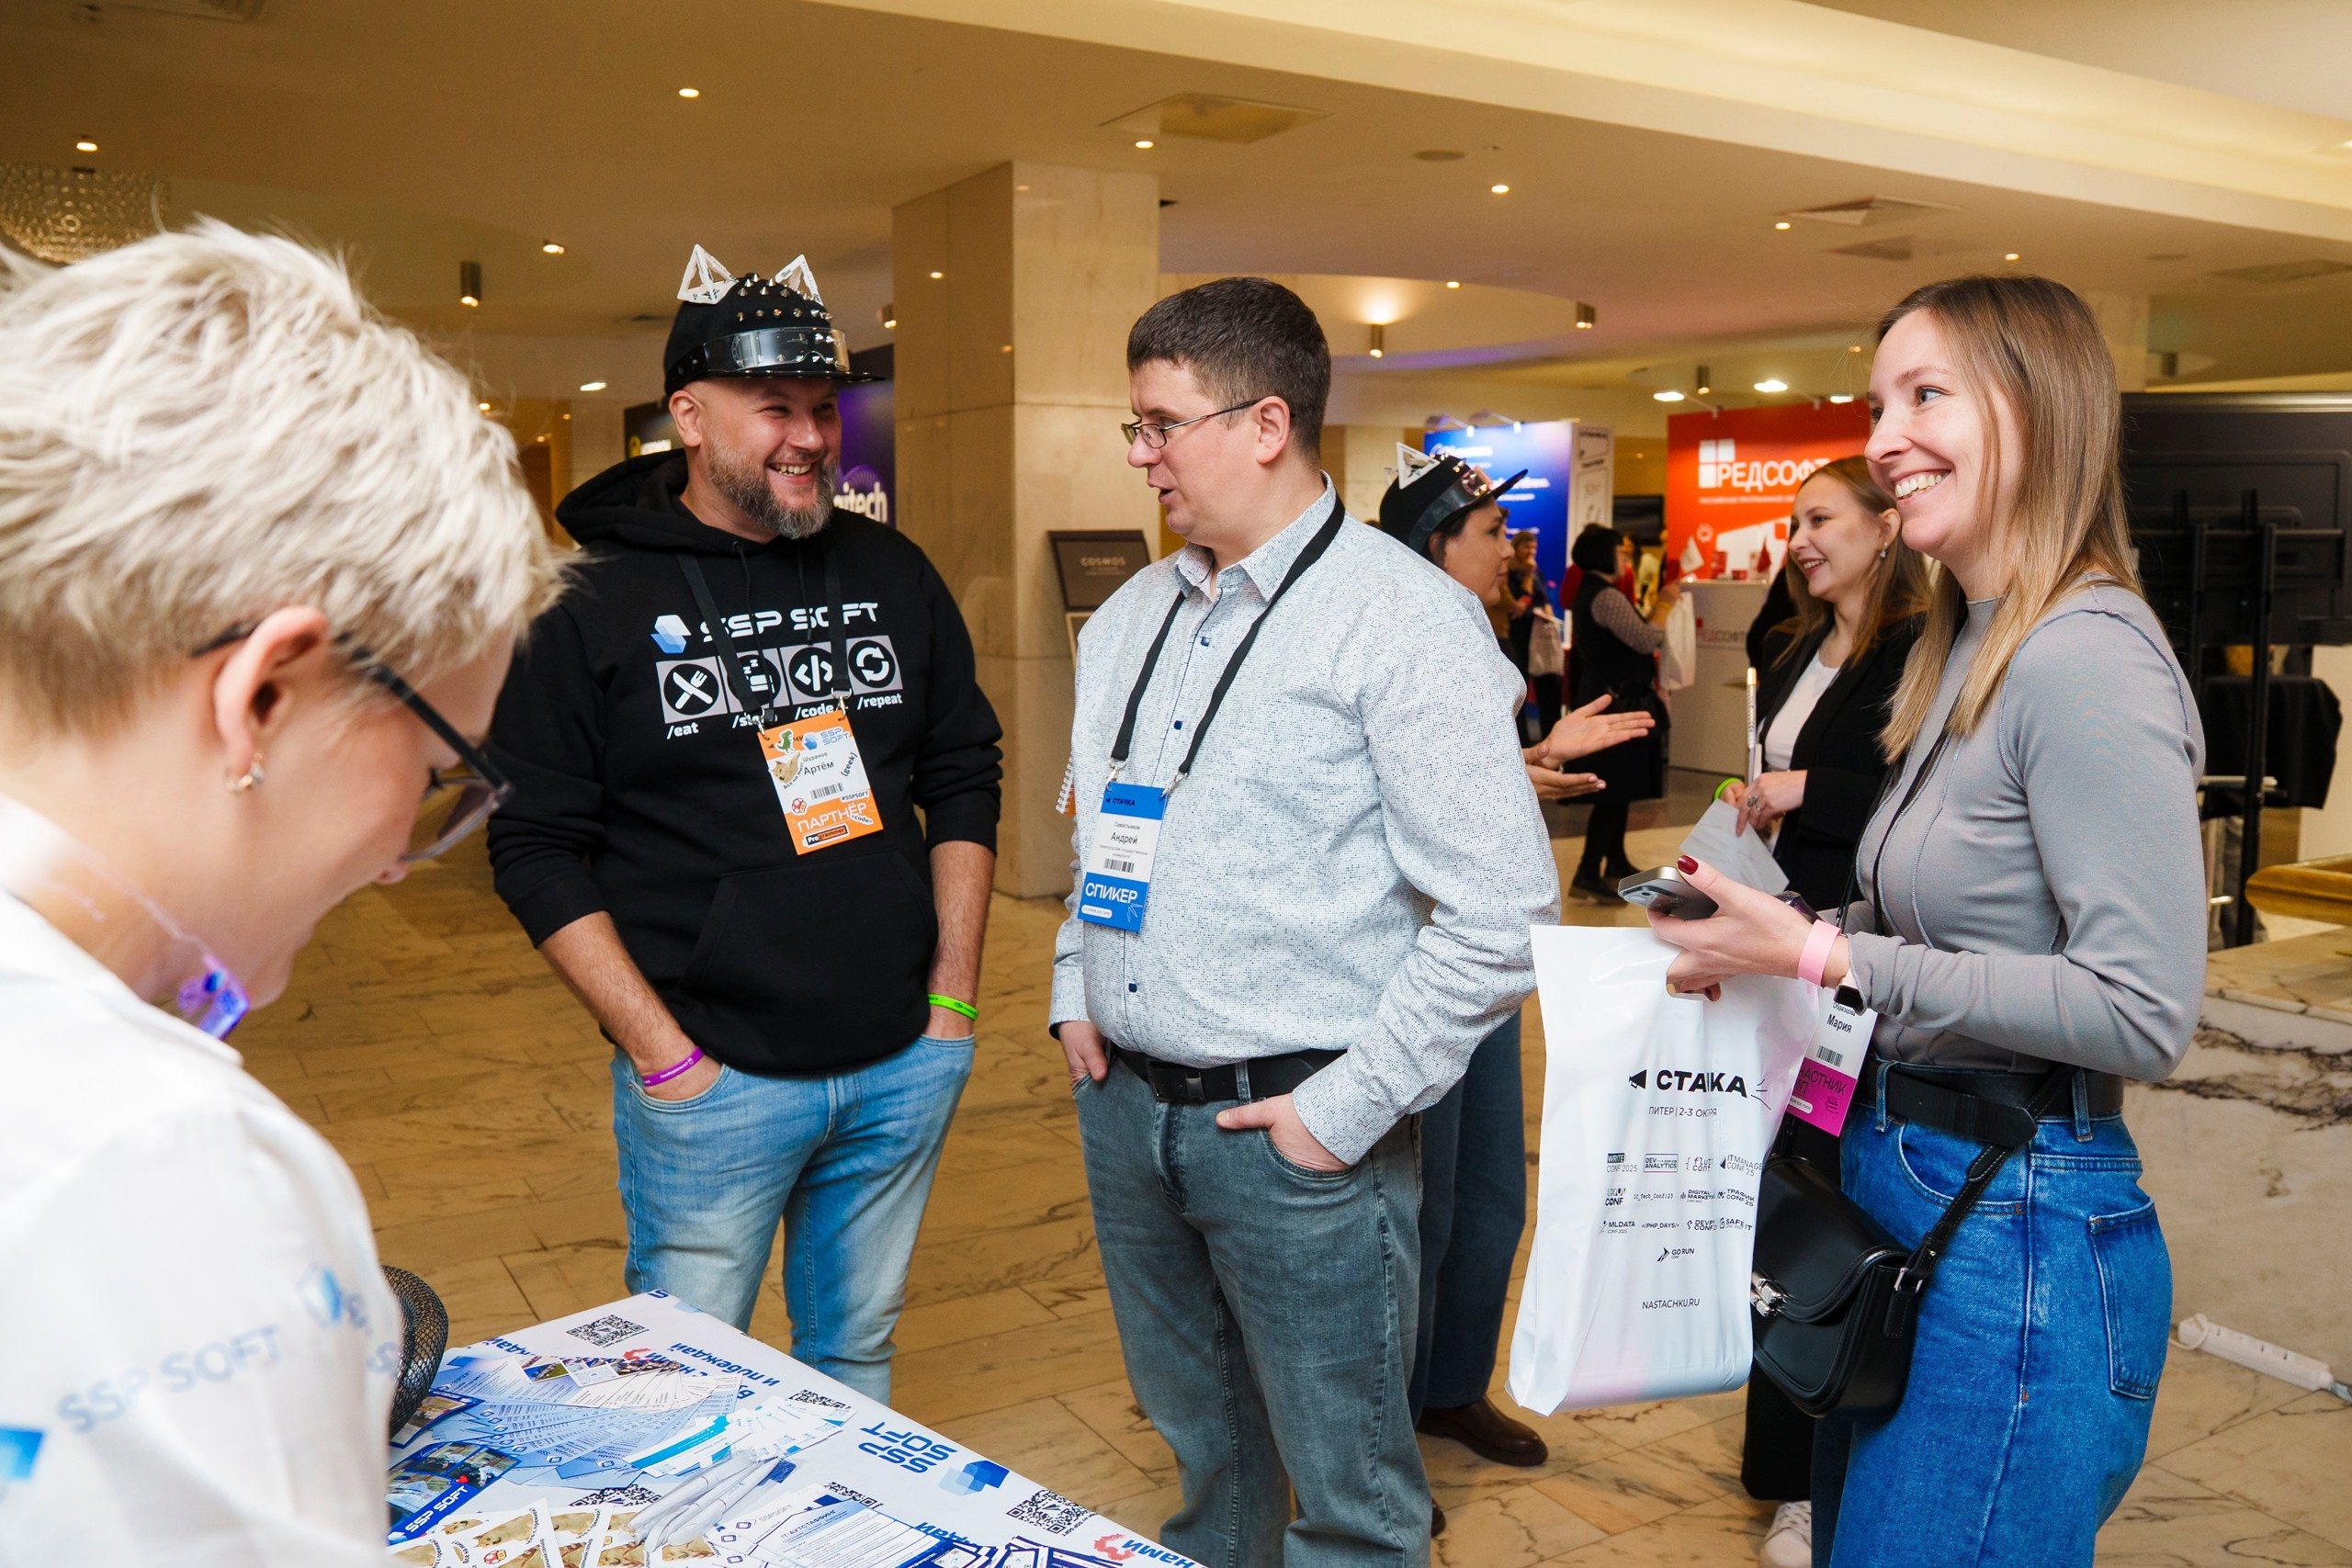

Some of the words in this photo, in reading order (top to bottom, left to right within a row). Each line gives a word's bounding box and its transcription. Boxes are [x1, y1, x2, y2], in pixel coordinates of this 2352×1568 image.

[856, 694, 903, 710] /repeat
[794, 703, 834, 720] /code
[666, 722, 699, 739] /eat
[803, 761, 834, 775] Артём
[1113, 797, 1136, 807] СТАЧКА
[797, 802, 867, 832] ПАРТНЁР
[1110, 832, 1138, 845] Андрей
[1085, 882, 1138, 904] СПИКЕР
[1826, 1013, 1852, 1034] Мария
[1657, 1069, 1747, 1099] СТАКА
[1648, 1106, 1674, 1116] ПИТЕР
[1607, 1165, 1621, 1173] CONF
[1622, 1164, 1638, 1172] 2025
[1605, 1197, 1623, 1206] CONF
[1642, 1297, 1700, 1311] NASTACHKU.RU
[159, 1323, 280, 1393] SOFT
[668, 1342, 765, 1382] побеждай
[762, 1378, 781, 1387] и
[860, 1422, 957, 1461] SOFT
[858, 1442, 937, 1473] SSP
[404, 1509, 435, 1533] SSP
[434, 1485, 469, 1512] SOFT
